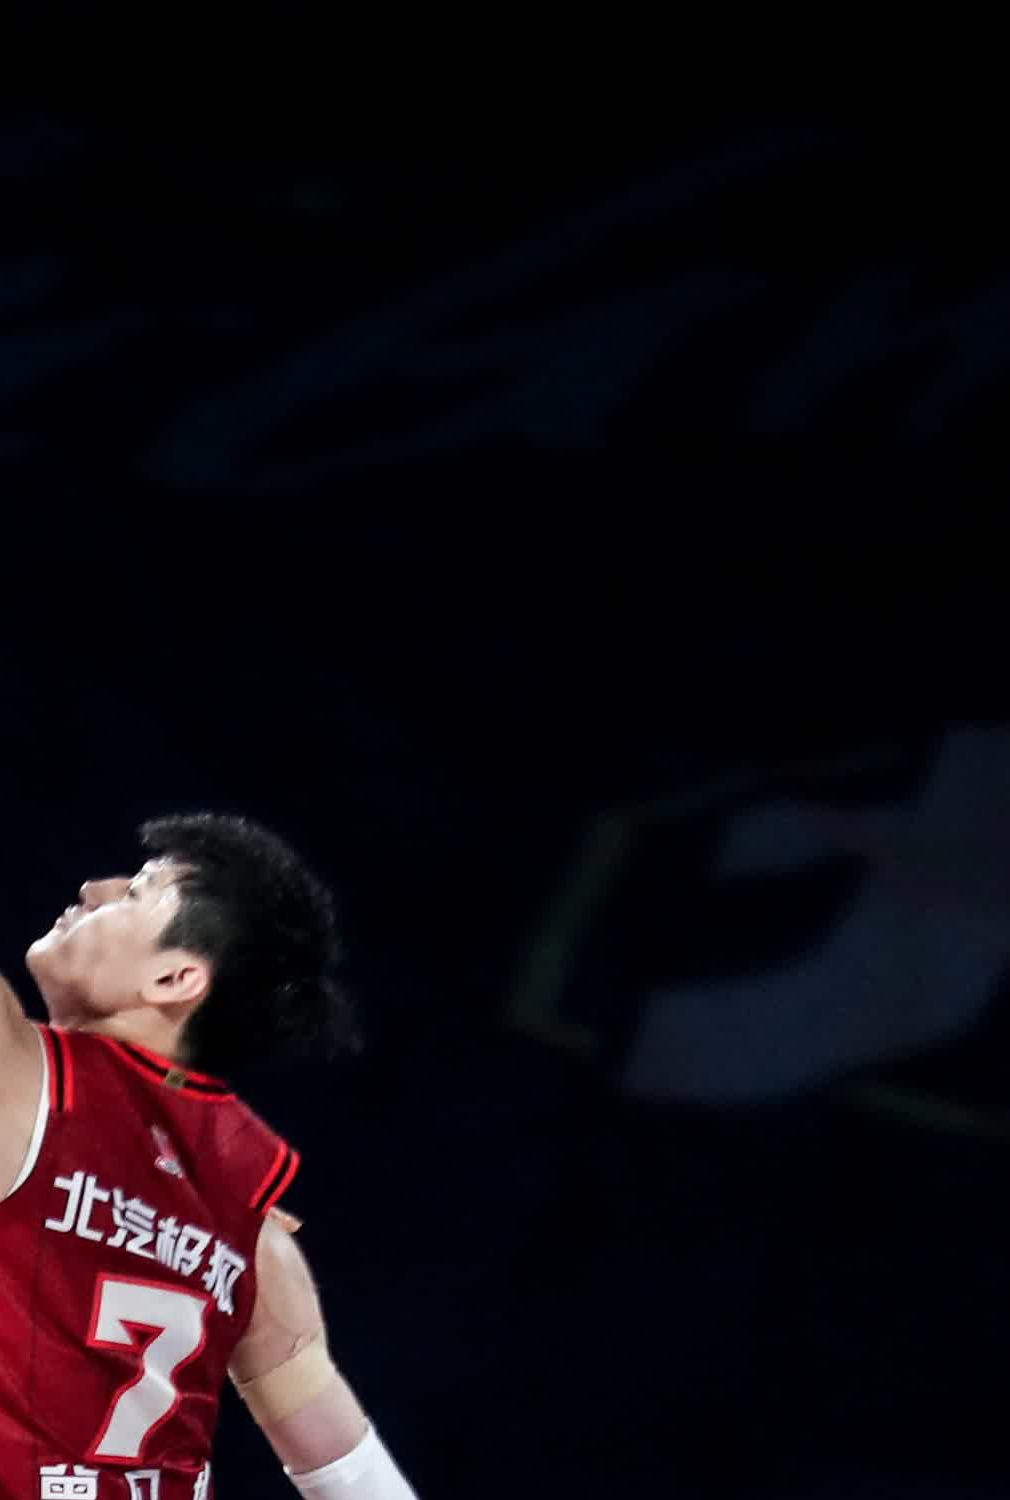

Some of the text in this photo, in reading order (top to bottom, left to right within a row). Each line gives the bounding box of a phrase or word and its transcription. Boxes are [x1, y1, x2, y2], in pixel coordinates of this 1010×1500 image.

[45, 1171, 247, 1316] 北汽极狐
[91, 1274, 210, 1462] 7
